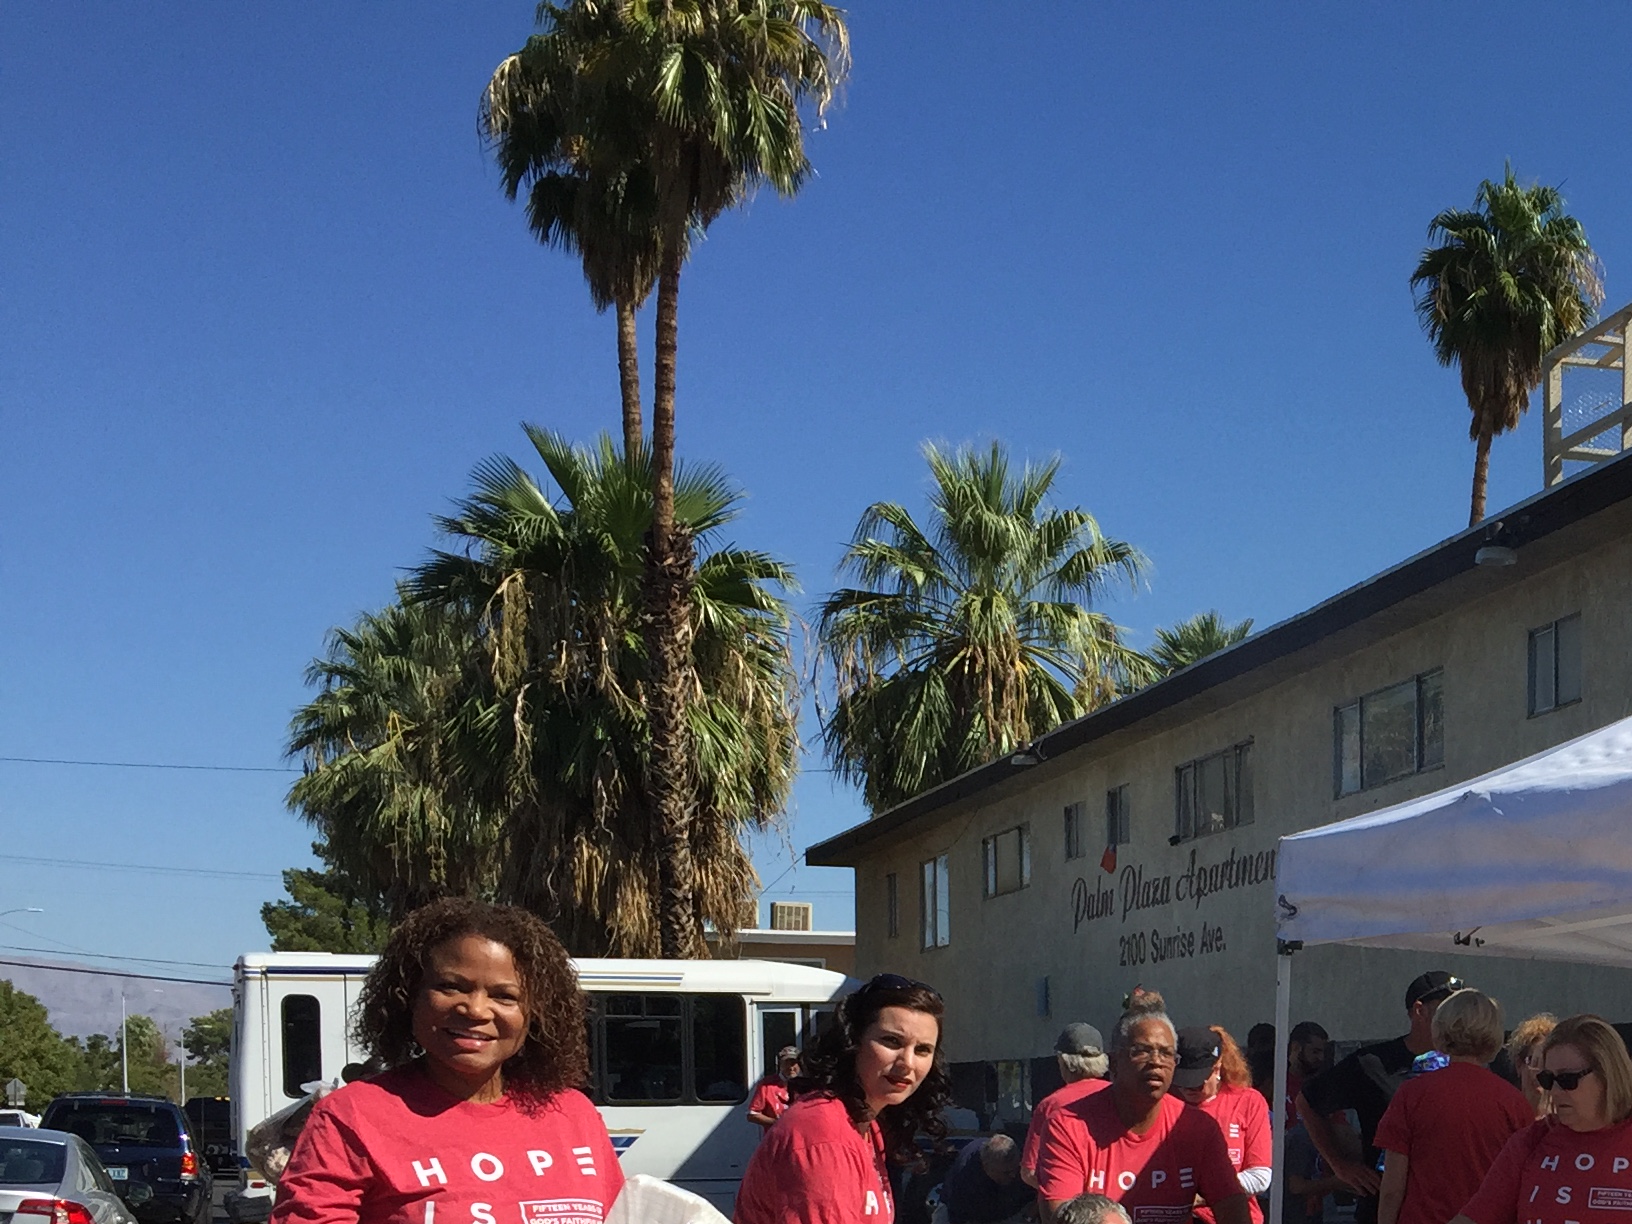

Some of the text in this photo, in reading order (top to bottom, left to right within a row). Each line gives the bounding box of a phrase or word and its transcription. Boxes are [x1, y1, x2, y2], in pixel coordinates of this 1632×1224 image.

[1071, 875, 1115, 934] Palm
[1120, 864, 1171, 923] Plaza
[1119, 921, 1227, 966] 2100 Sunrise Ave.
[411, 1146, 598, 1187] HOPE
[1089, 1166, 1195, 1191] HOPE
[1529, 1185, 1573, 1204] IS
